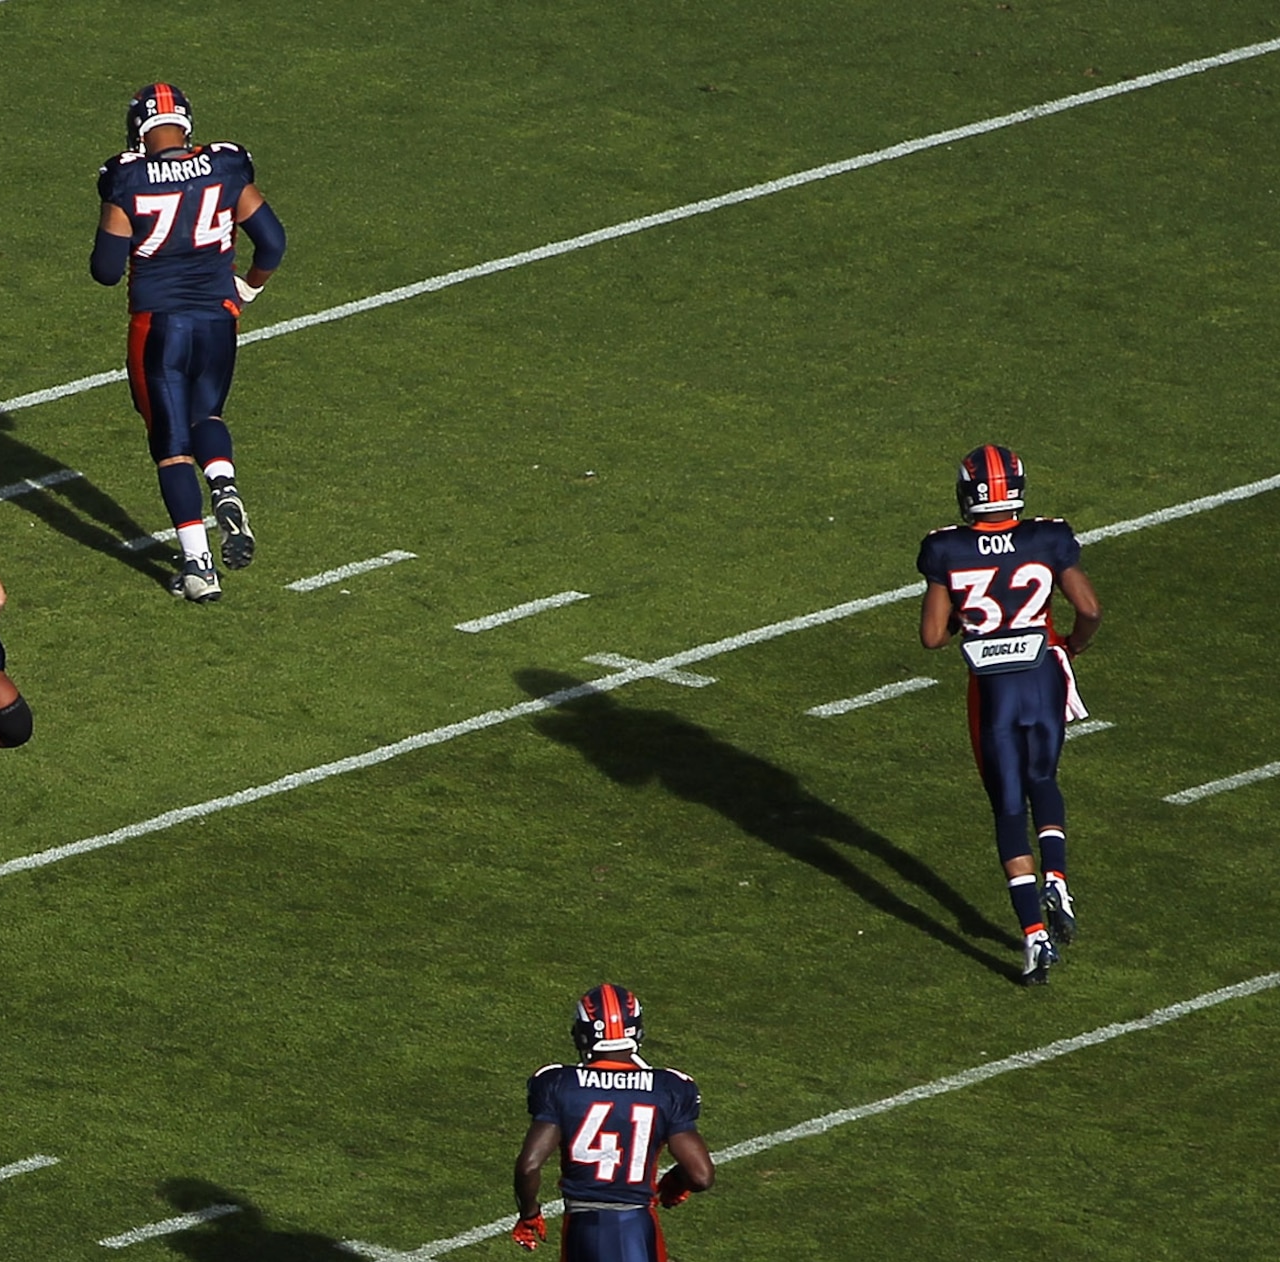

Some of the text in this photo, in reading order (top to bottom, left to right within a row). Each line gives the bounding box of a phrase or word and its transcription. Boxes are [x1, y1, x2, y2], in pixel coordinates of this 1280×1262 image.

[146, 153, 212, 184] HARRIS
[133, 183, 236, 260] 74
[977, 532, 1016, 555] COX
[947, 563, 1055, 639] 32
[981, 642, 1027, 658] DOUGLAS
[575, 1065, 654, 1092] VAUGHN
[569, 1101, 656, 1184] 41
